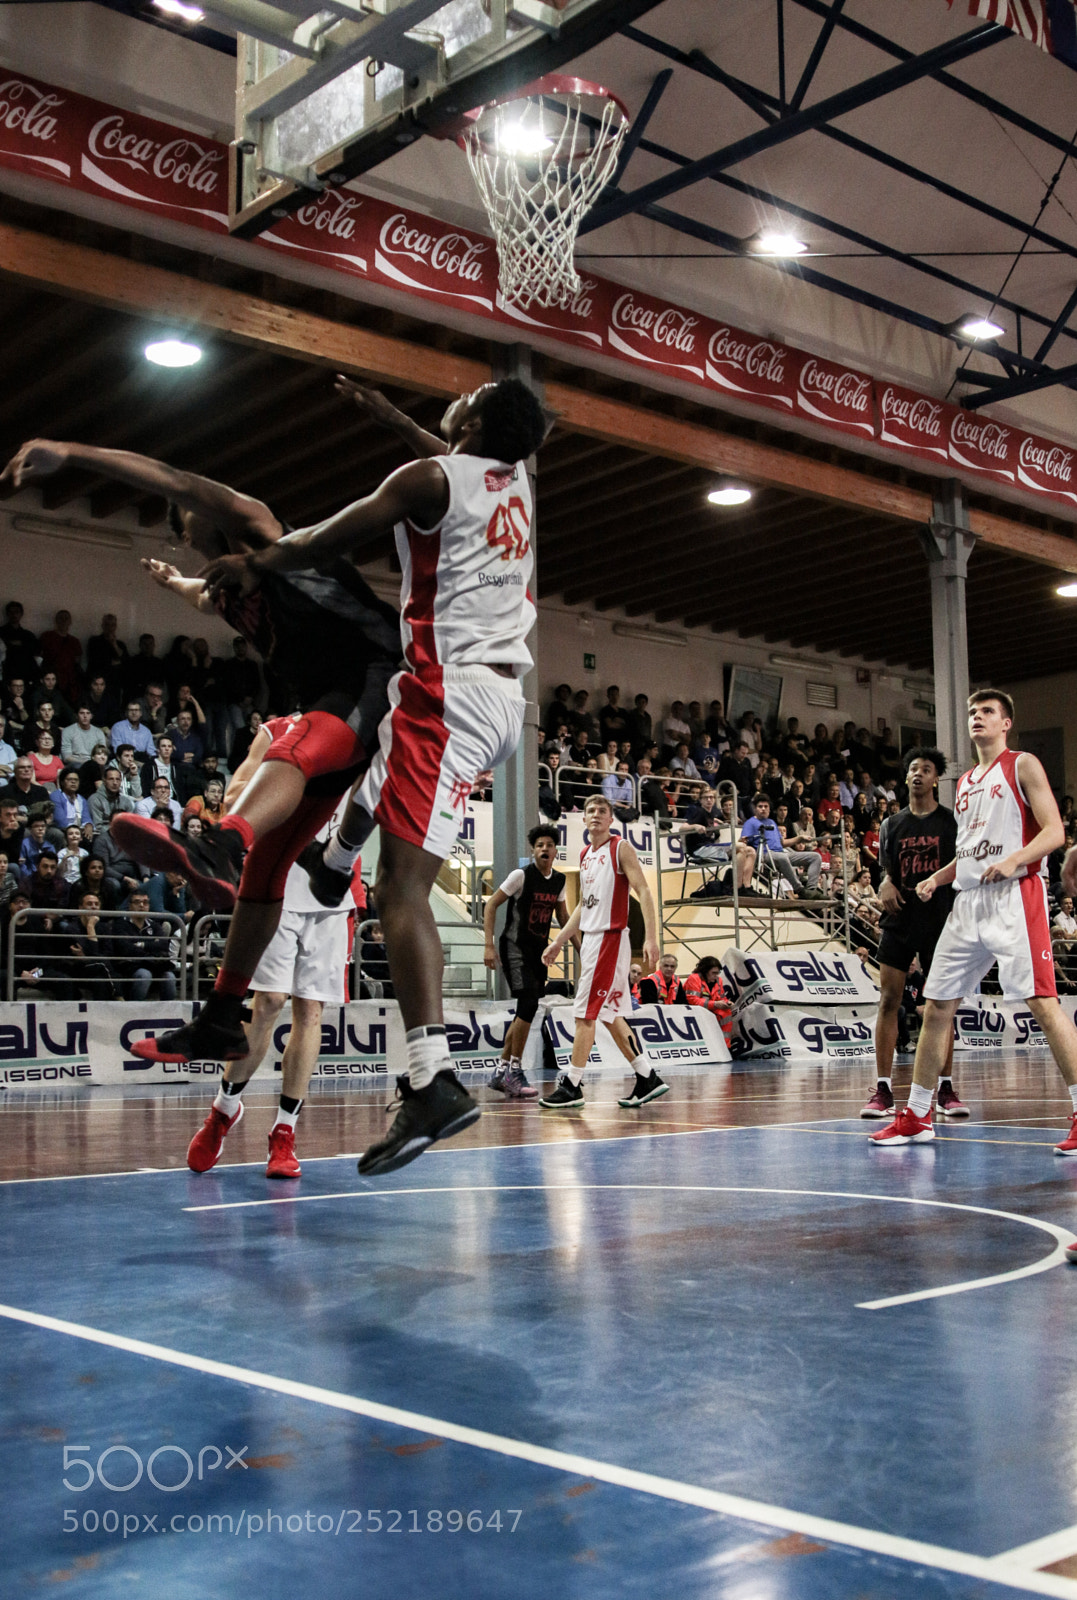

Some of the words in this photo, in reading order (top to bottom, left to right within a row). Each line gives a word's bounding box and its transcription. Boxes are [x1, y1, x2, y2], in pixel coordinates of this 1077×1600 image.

[900, 836, 940, 848] TEAM
[807, 987, 860, 996] LISSONE
[962, 1038, 1003, 1047] LISSONE
[647, 1047, 711, 1060] LISSONE
[0, 1064, 93, 1083] ISSONE
[162, 1060, 225, 1075] LISSON
